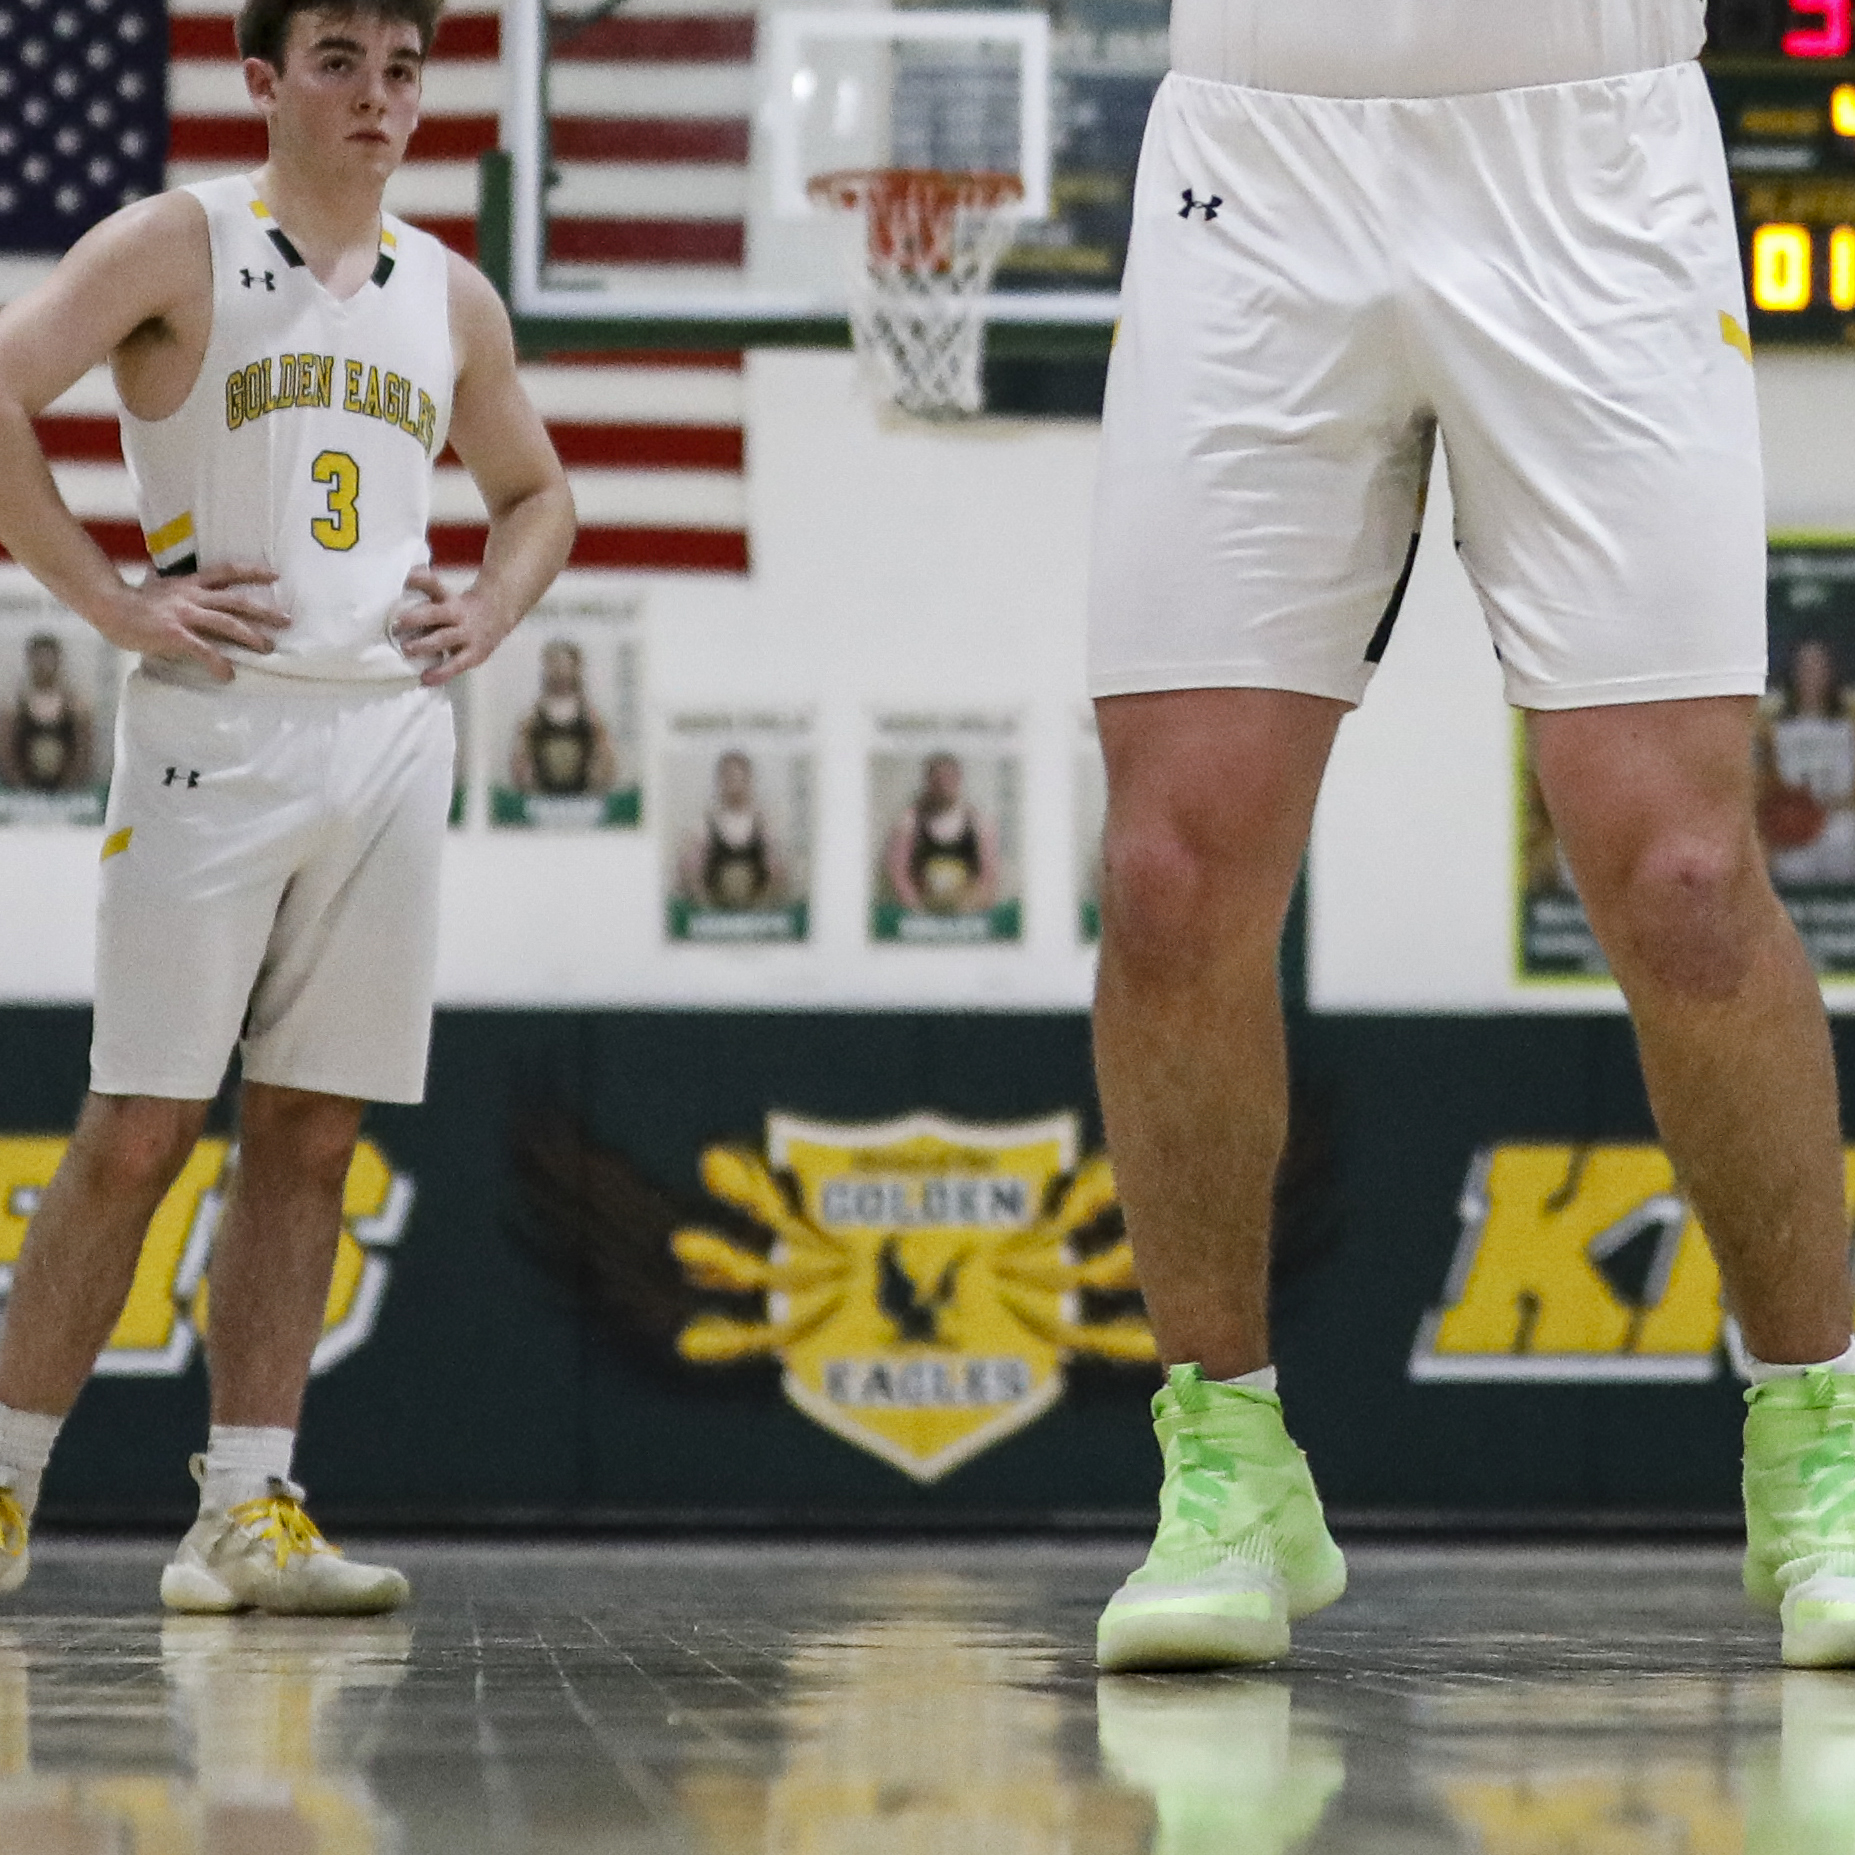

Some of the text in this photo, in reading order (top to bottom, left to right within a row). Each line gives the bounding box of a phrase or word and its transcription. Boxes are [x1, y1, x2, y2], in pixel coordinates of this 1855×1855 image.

[226, 353, 334, 431] GOLDEN
[311, 450, 359, 551] 3
[822, 1178, 1028, 1227] GOLDEN
[824, 1359, 1031, 1408] EAGLES
